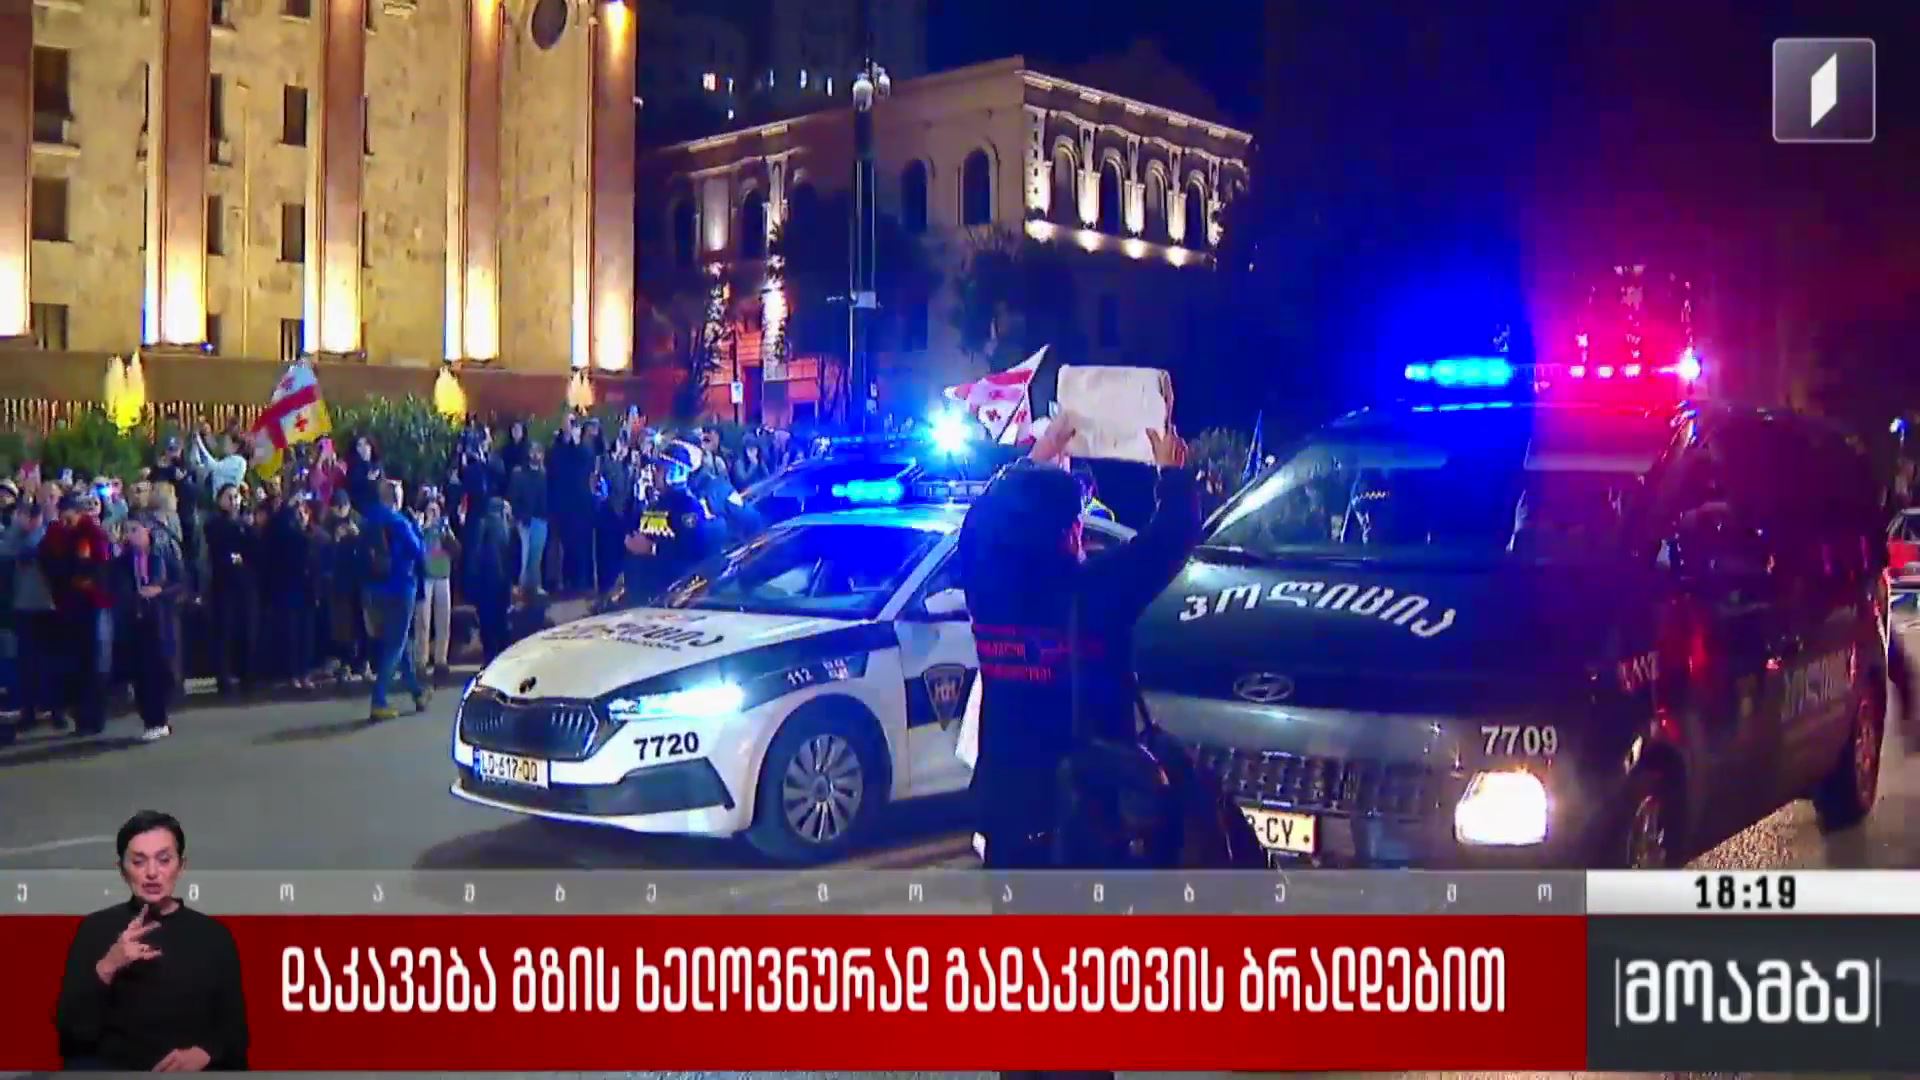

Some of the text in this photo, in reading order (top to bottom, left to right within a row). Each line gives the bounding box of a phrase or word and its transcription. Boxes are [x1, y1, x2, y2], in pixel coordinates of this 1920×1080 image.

[1179, 581, 1457, 638] პოლიცია
[787, 667, 814, 687] 112
[633, 730, 700, 761] 7720
[1480, 725, 1558, 756] 7709
